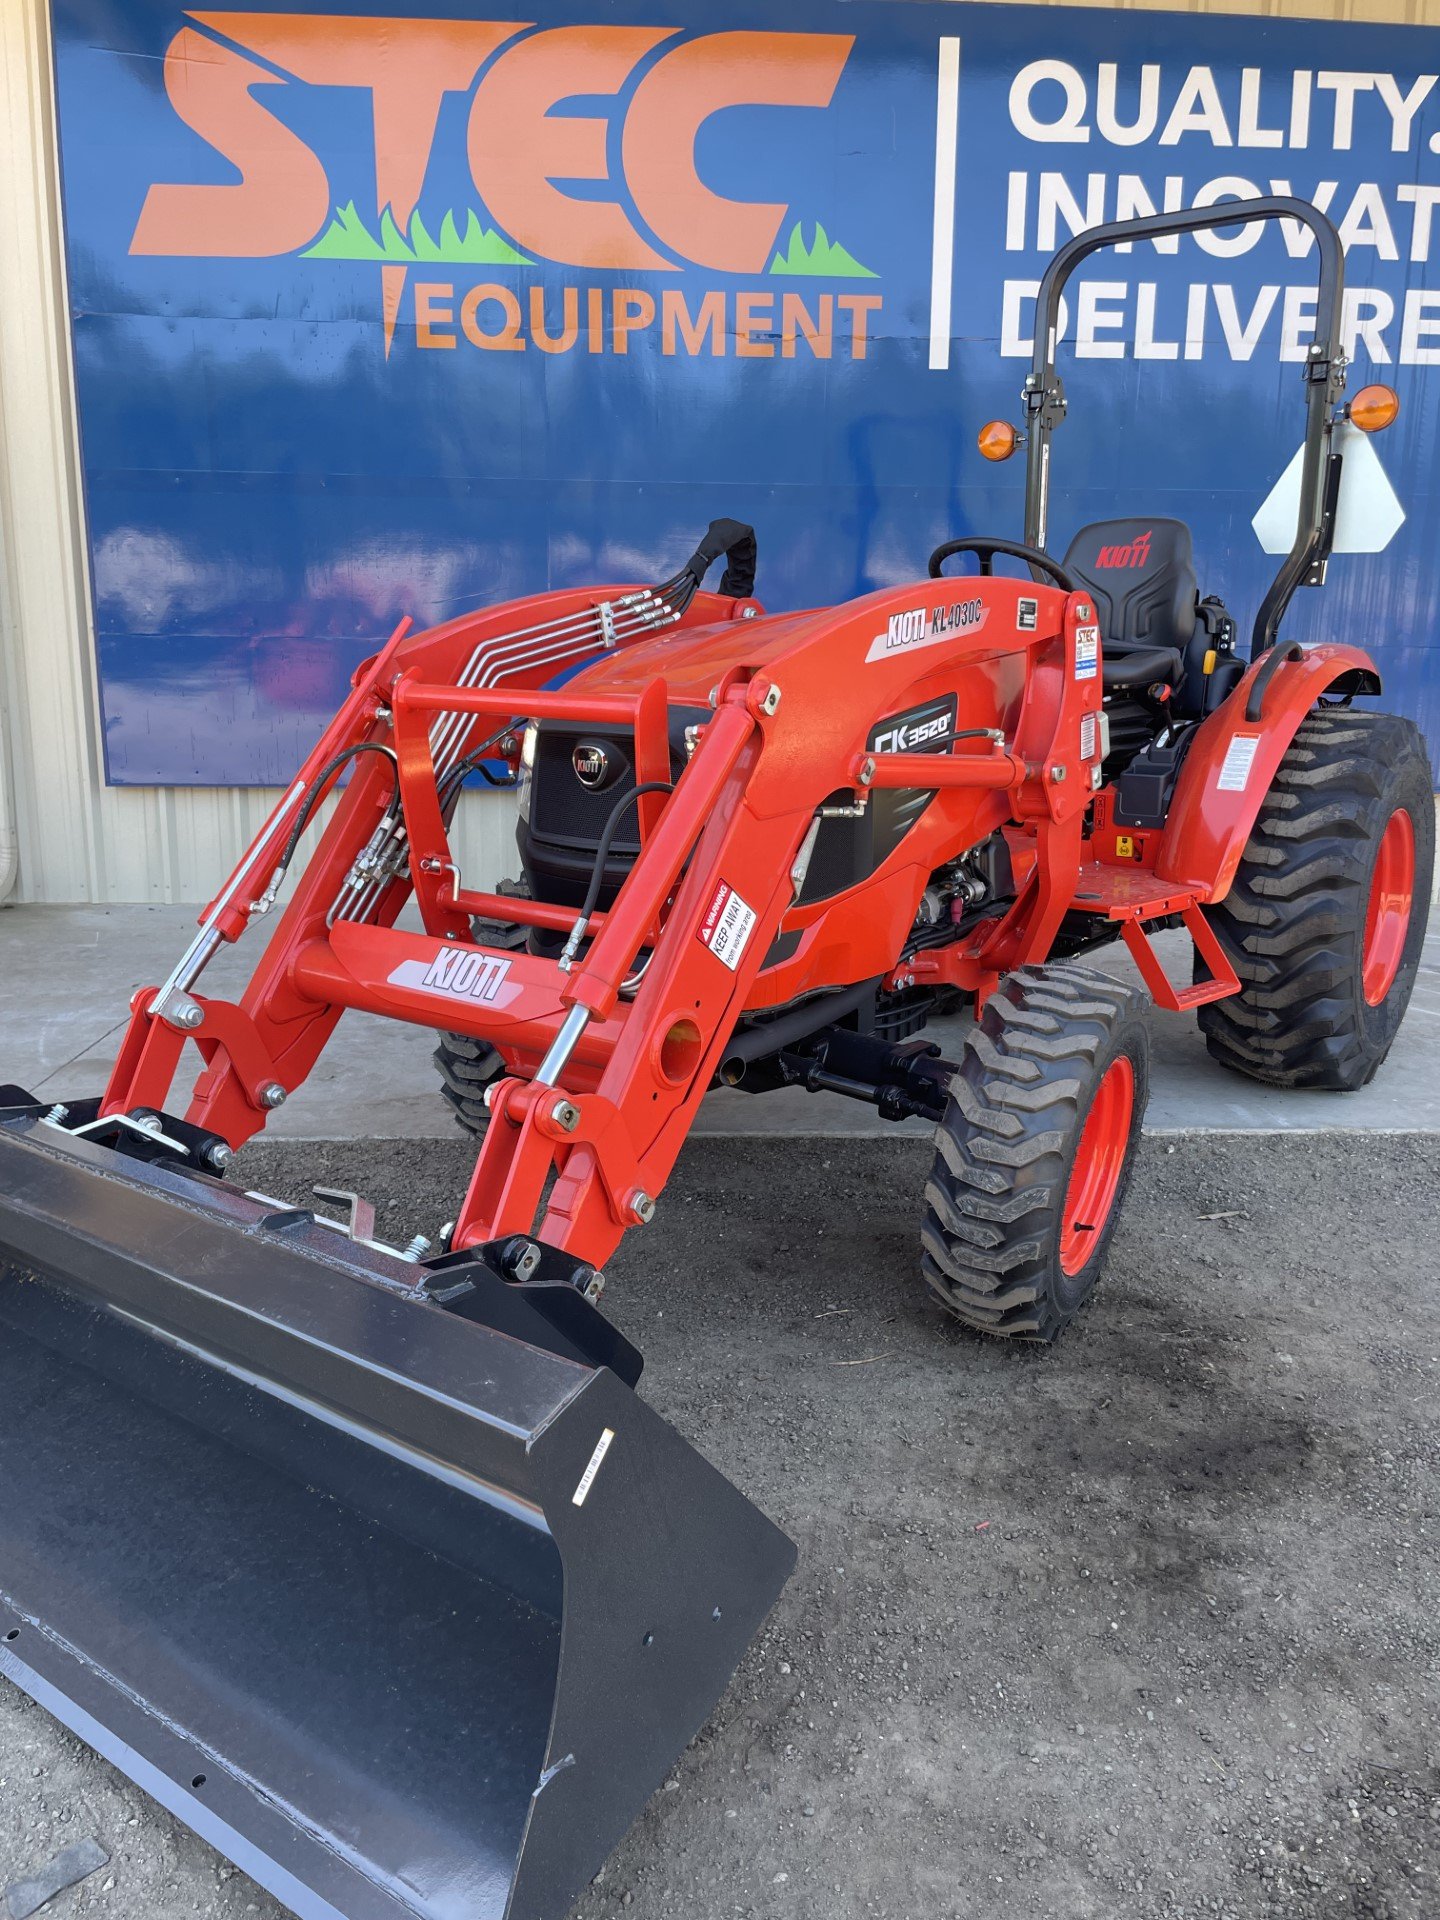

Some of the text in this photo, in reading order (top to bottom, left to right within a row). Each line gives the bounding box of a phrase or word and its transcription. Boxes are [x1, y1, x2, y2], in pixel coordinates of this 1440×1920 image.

[128, 10, 857, 275] STEC
[413, 283, 884, 361] EQUIPMENT
[1095, 544, 1152, 569] KIOTI
[886, 606, 927, 650] KIOTI
[577, 759, 599, 773] KIOTI
[706, 884, 729, 927] WARNING
[713, 897, 742, 956] KEEP AWAY
[726, 910, 753, 965] from working area
[422, 945, 514, 1001] KIOTI
